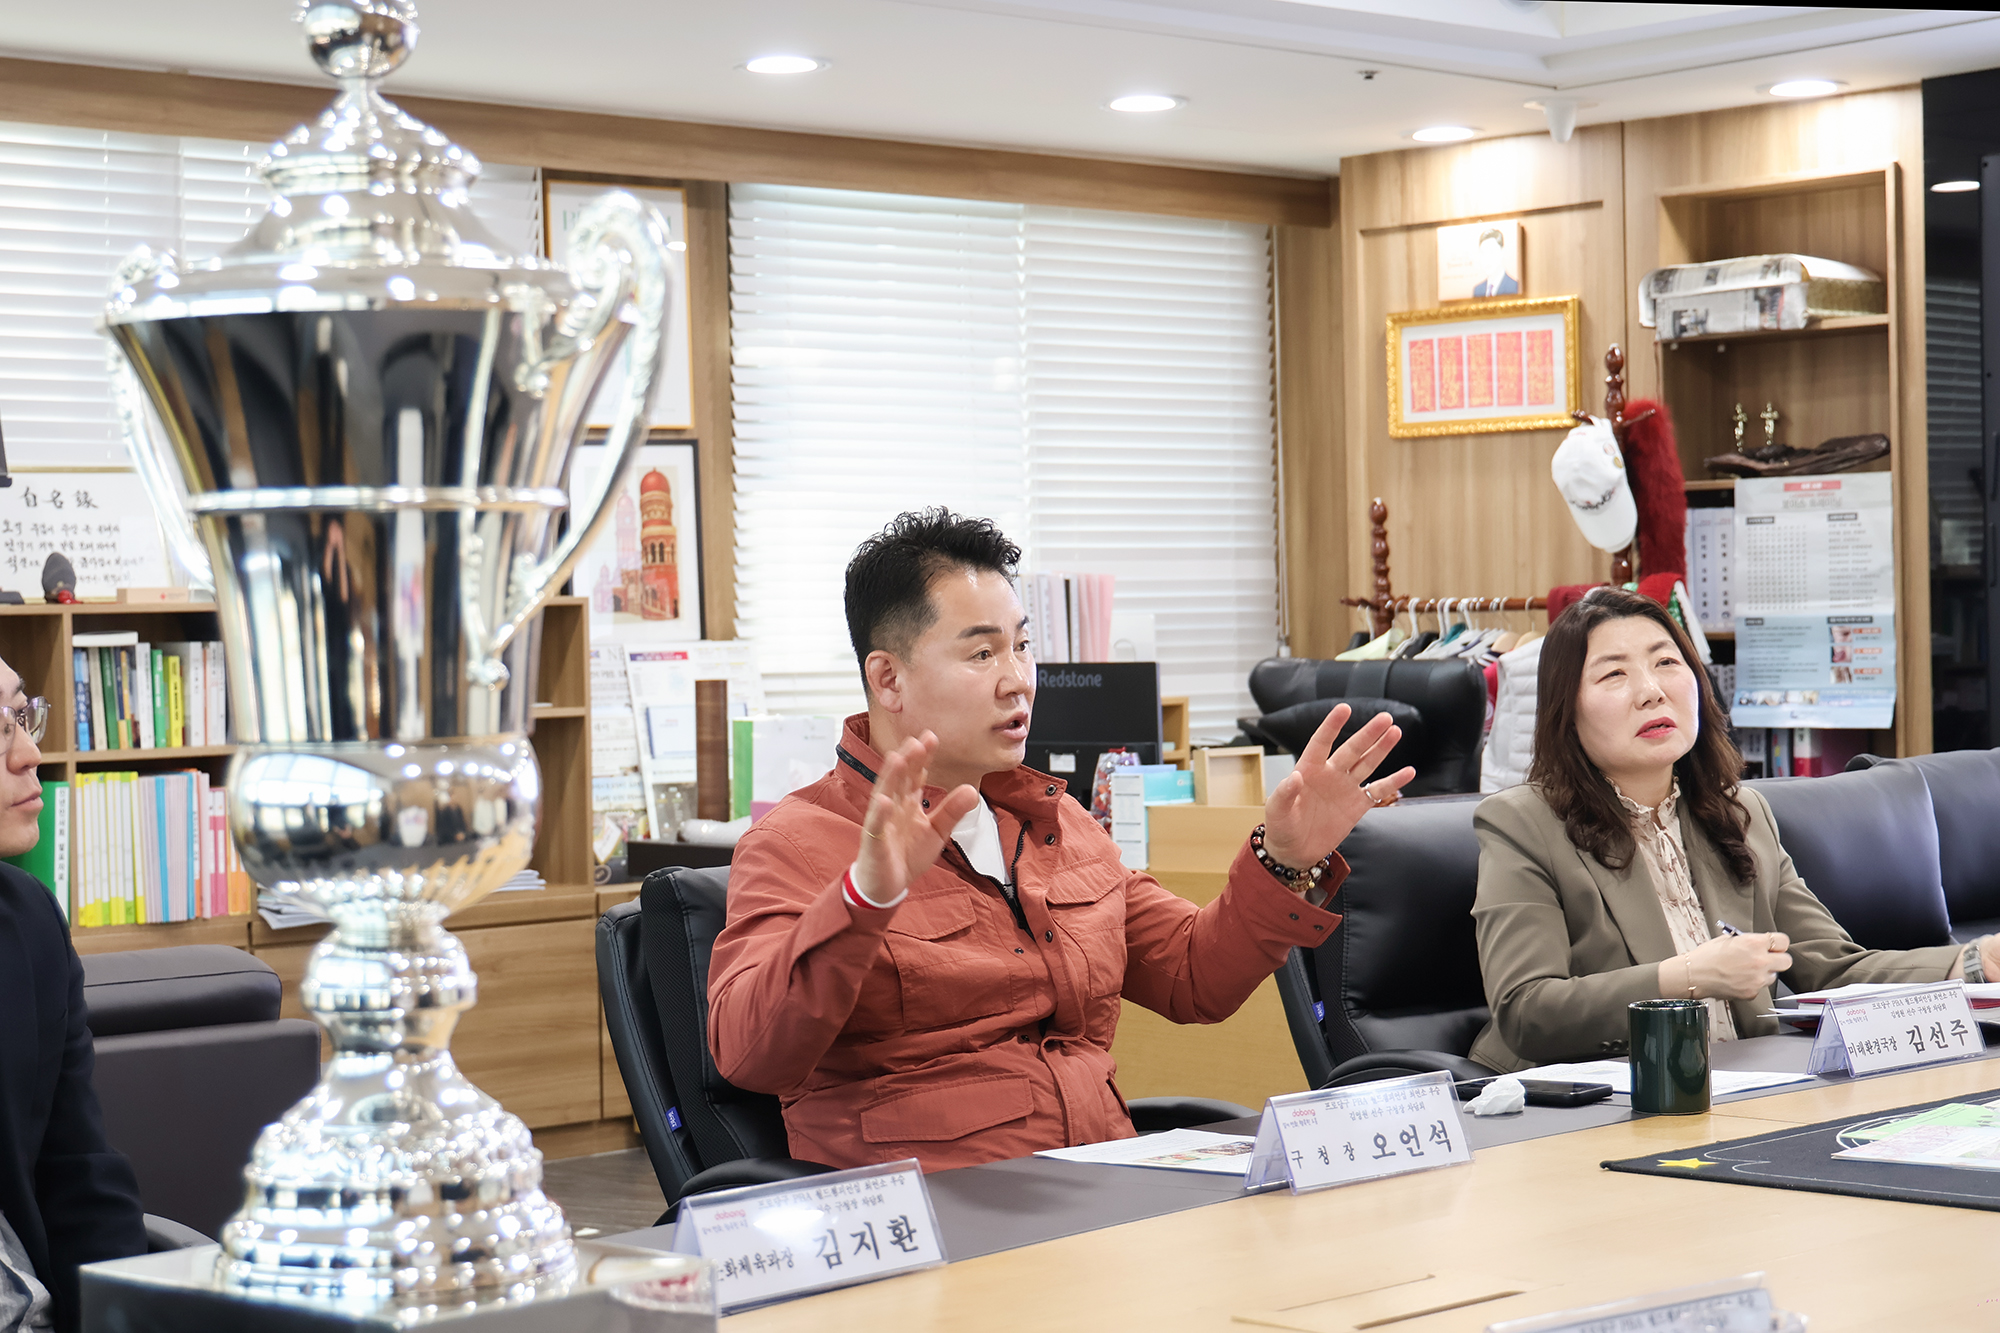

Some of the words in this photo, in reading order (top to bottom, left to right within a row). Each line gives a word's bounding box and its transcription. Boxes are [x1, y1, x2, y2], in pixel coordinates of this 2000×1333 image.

[1038, 669, 1102, 688] Redstone
[1847, 1035, 1898, 1058] 미래환경국장
[1905, 1019, 1969, 1054] 김선주
[1292, 1108, 1315, 1117] dobong
[1371, 1107, 1384, 1118] 선수
[1371, 1119, 1453, 1160] 오언석
[813, 1214, 919, 1270] 김지환
